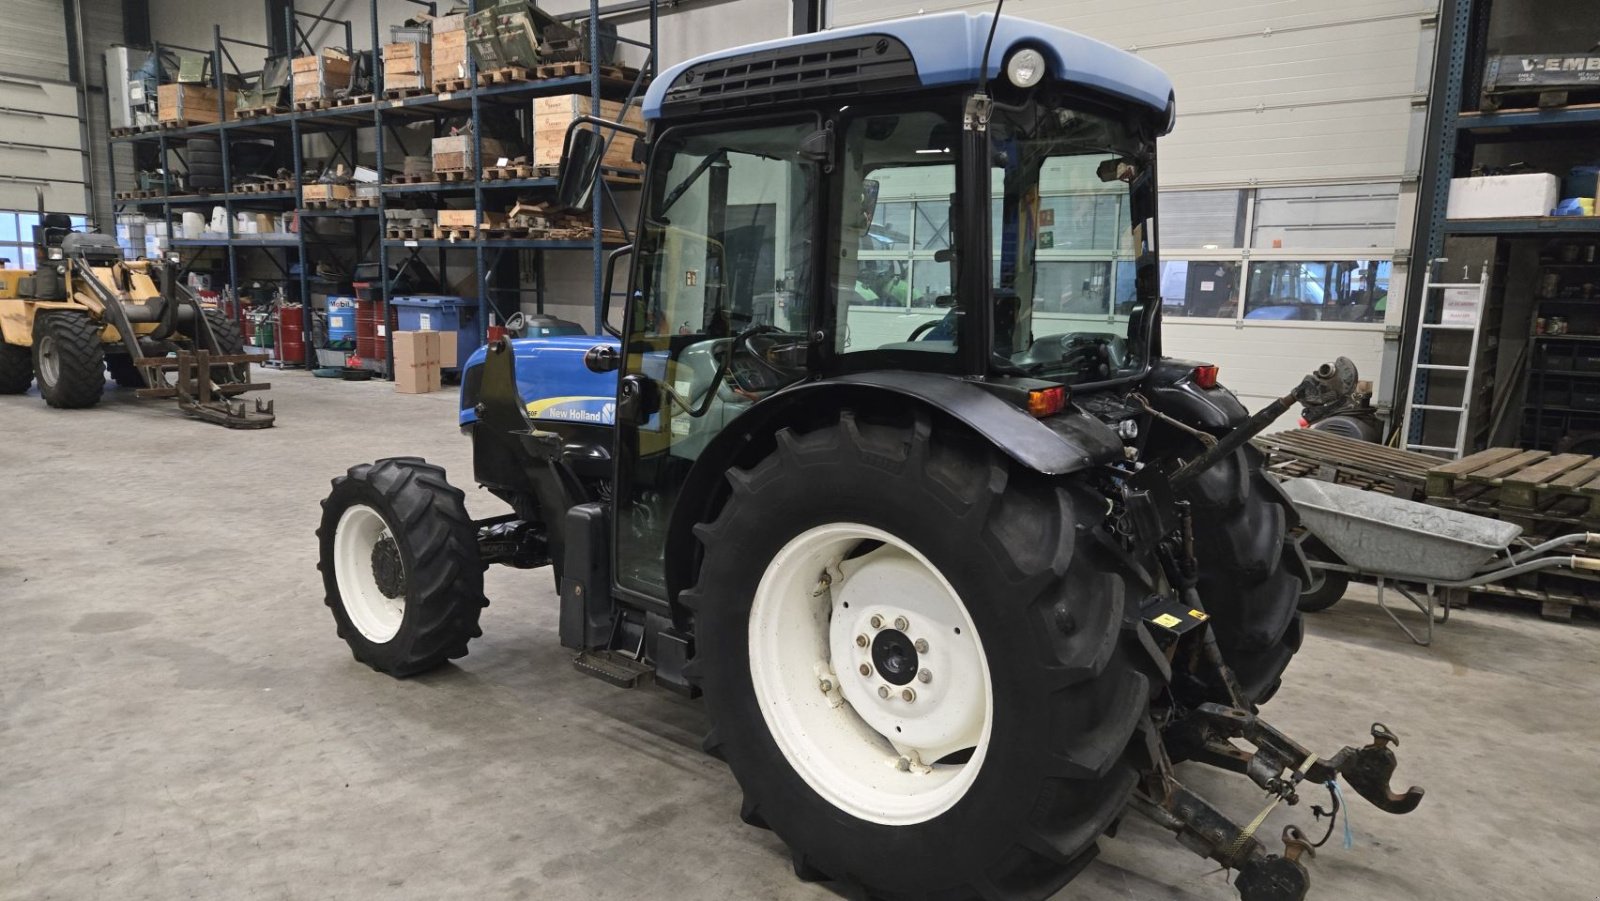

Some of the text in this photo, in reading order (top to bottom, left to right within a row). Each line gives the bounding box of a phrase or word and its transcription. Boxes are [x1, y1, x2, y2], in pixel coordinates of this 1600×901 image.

[1463, 264, 1469, 280] 1
[330, 300, 350, 308] Mobil
[549, 407, 600, 421] New Holland
